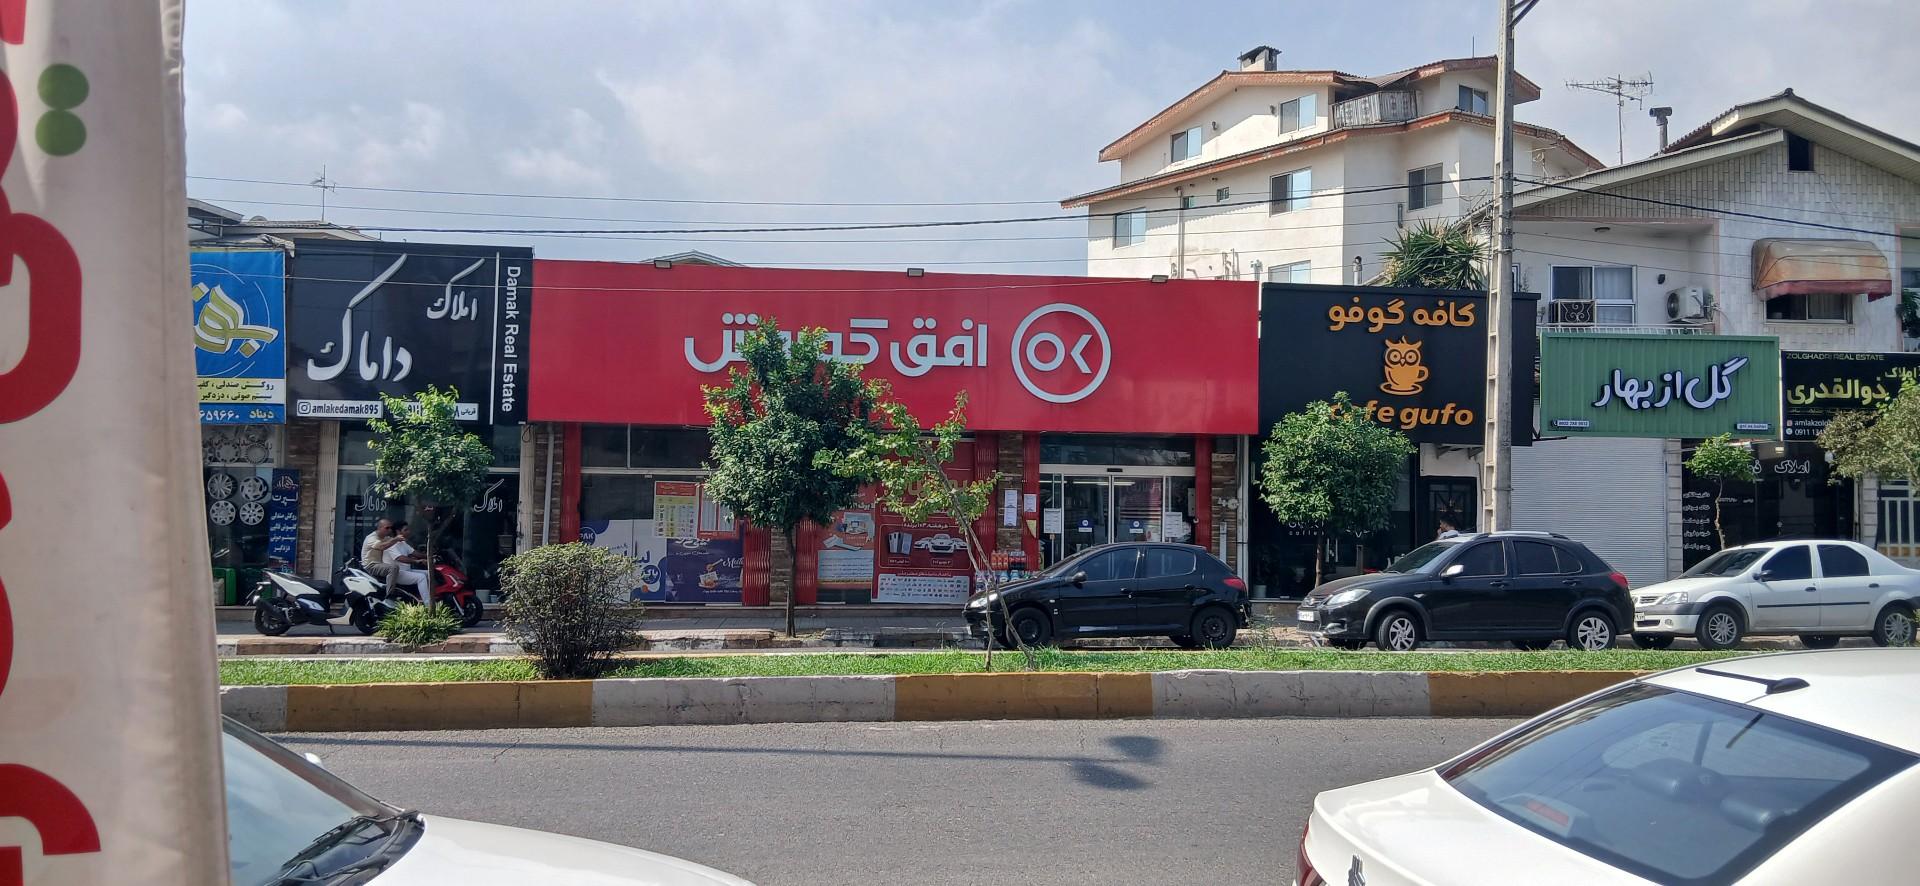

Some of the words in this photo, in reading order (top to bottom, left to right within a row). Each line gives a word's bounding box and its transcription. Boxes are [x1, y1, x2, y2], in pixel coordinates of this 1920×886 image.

[427, 258, 486, 321] املاک
[505, 266, 521, 320] Damak
[307, 253, 413, 383] داماک
[1328, 296, 1406, 333] گوفو
[1412, 299, 1476, 328] کافه
[503, 323, 519, 358] Real
[889, 317, 989, 378] افق
[1833, 353, 1855, 361] REAL
[501, 362, 518, 412] Estate
[1592, 368, 1655, 410] بهار
[1653, 370, 1682, 408] از
[1685, 356, 1749, 409] گل
[1786, 376, 1888, 406] ذوالقدری
[1884, 366, 1918, 379] املاک
[311, 403, 379, 415] amlakedamak895
[1399, 402, 1474, 430] gufo
[1774, 459, 1810, 474] املاک
